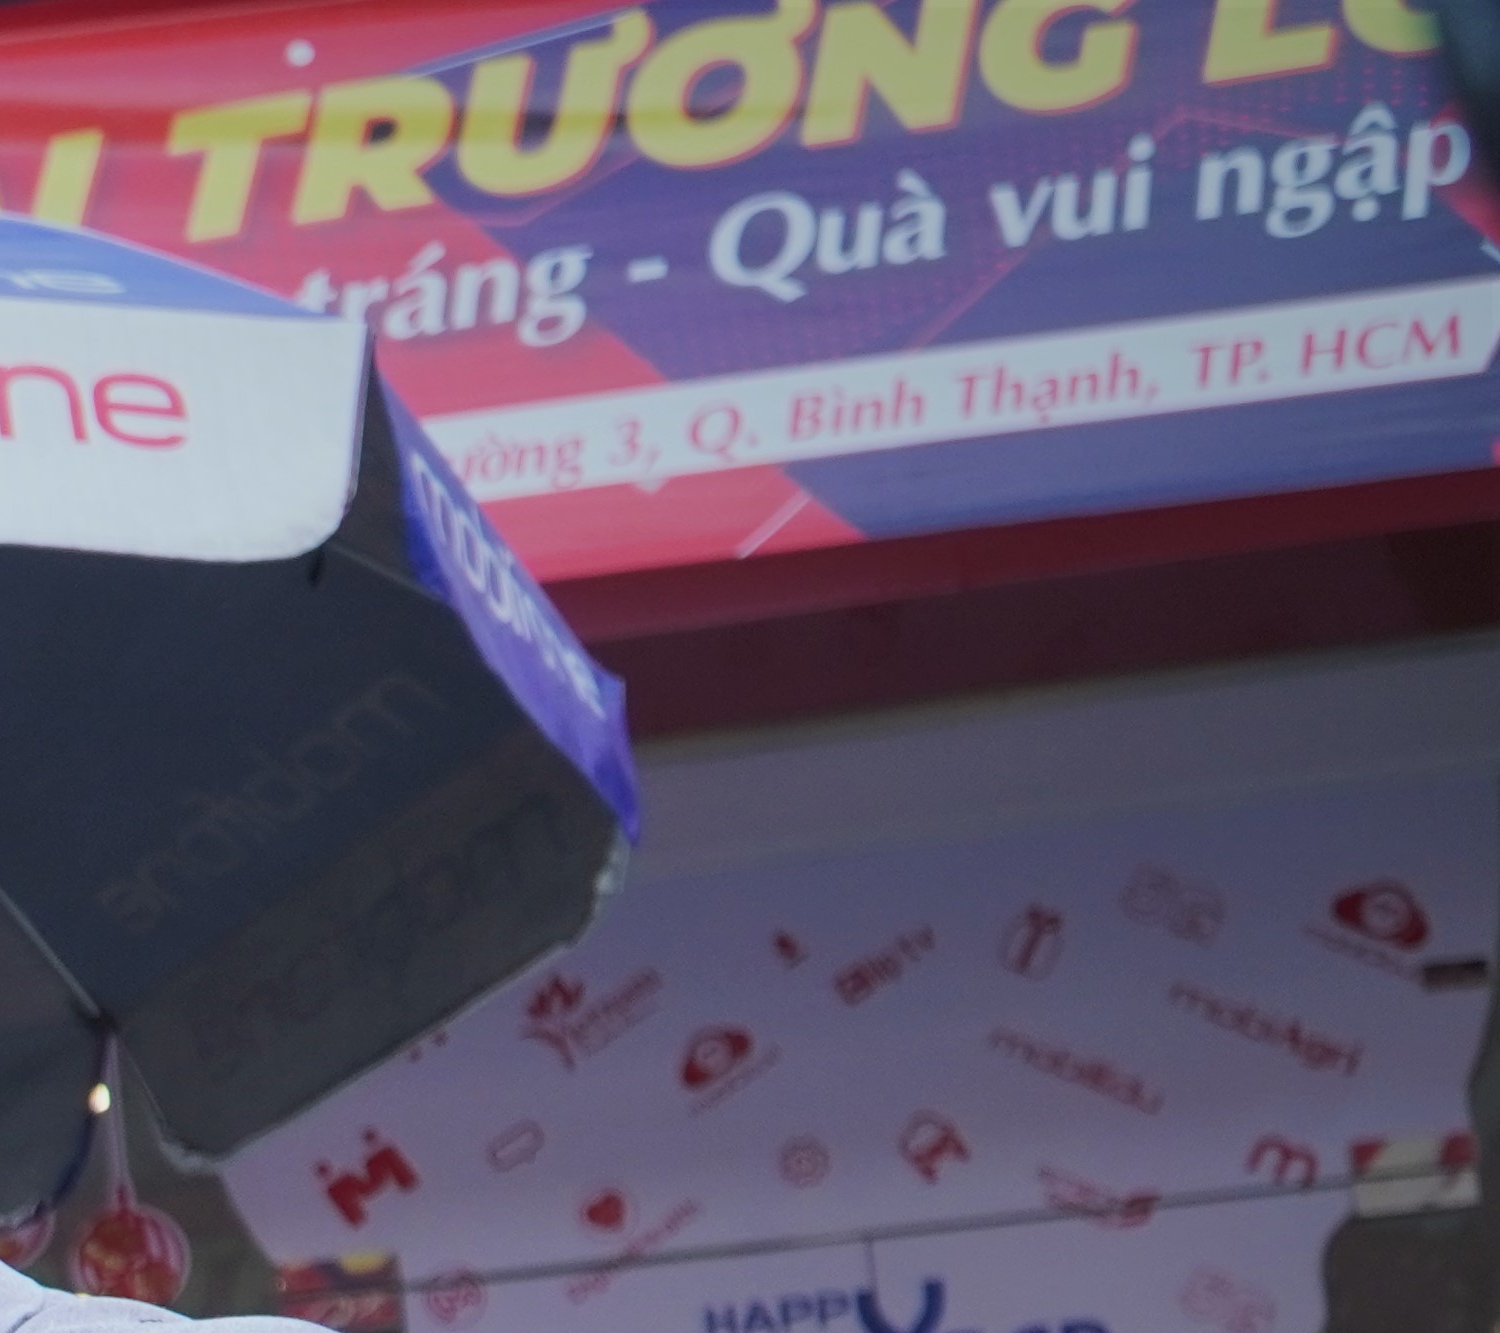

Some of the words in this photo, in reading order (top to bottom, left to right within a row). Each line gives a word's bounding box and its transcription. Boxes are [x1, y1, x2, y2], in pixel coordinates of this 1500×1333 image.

[709, 168, 947, 303] Quà
[990, 135, 1152, 250] vui
[1195, 100, 1473, 238] ngập
[690, 408, 760, 465] Q.
[788, 382, 927, 441] Bình
[955, 350, 1160, 423] Thạnh,
[1192, 340, 1272, 391] TP.
[1298, 313, 1463, 375] HCM
